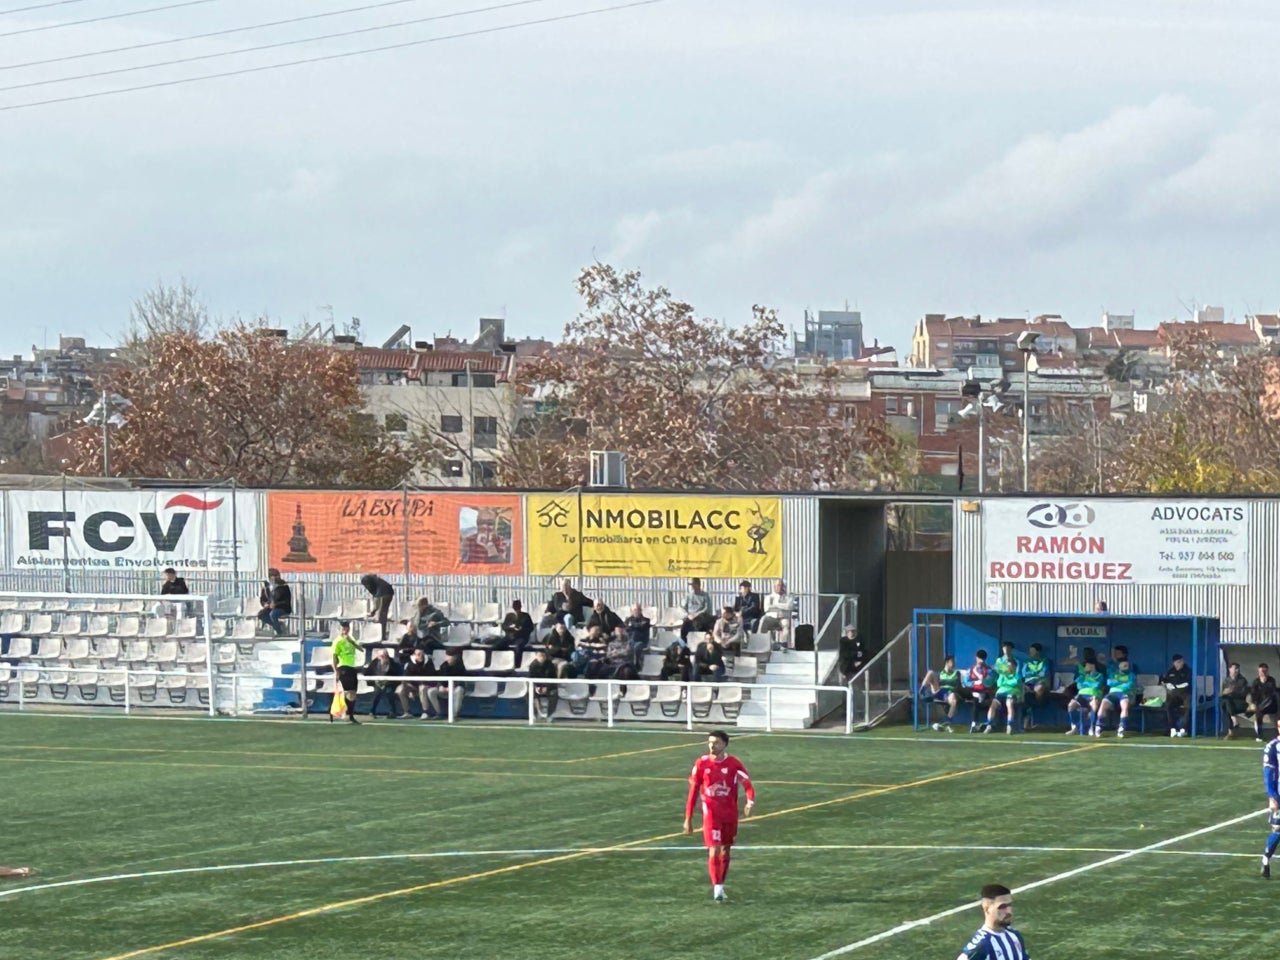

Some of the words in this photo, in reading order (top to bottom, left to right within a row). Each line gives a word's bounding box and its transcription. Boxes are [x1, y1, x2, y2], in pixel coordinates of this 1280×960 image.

[582, 509, 741, 529] NMOBILACC
[1151, 506, 1244, 521] ADVOCATS
[27, 510, 190, 552] FCV
[561, 534, 576, 543] Tu
[646, 536, 660, 545] en
[1016, 532, 1105, 554] RAMÓN
[16, 555, 110, 567] Aislamentos
[989, 556, 1133, 580] RODRÍGUEZ
